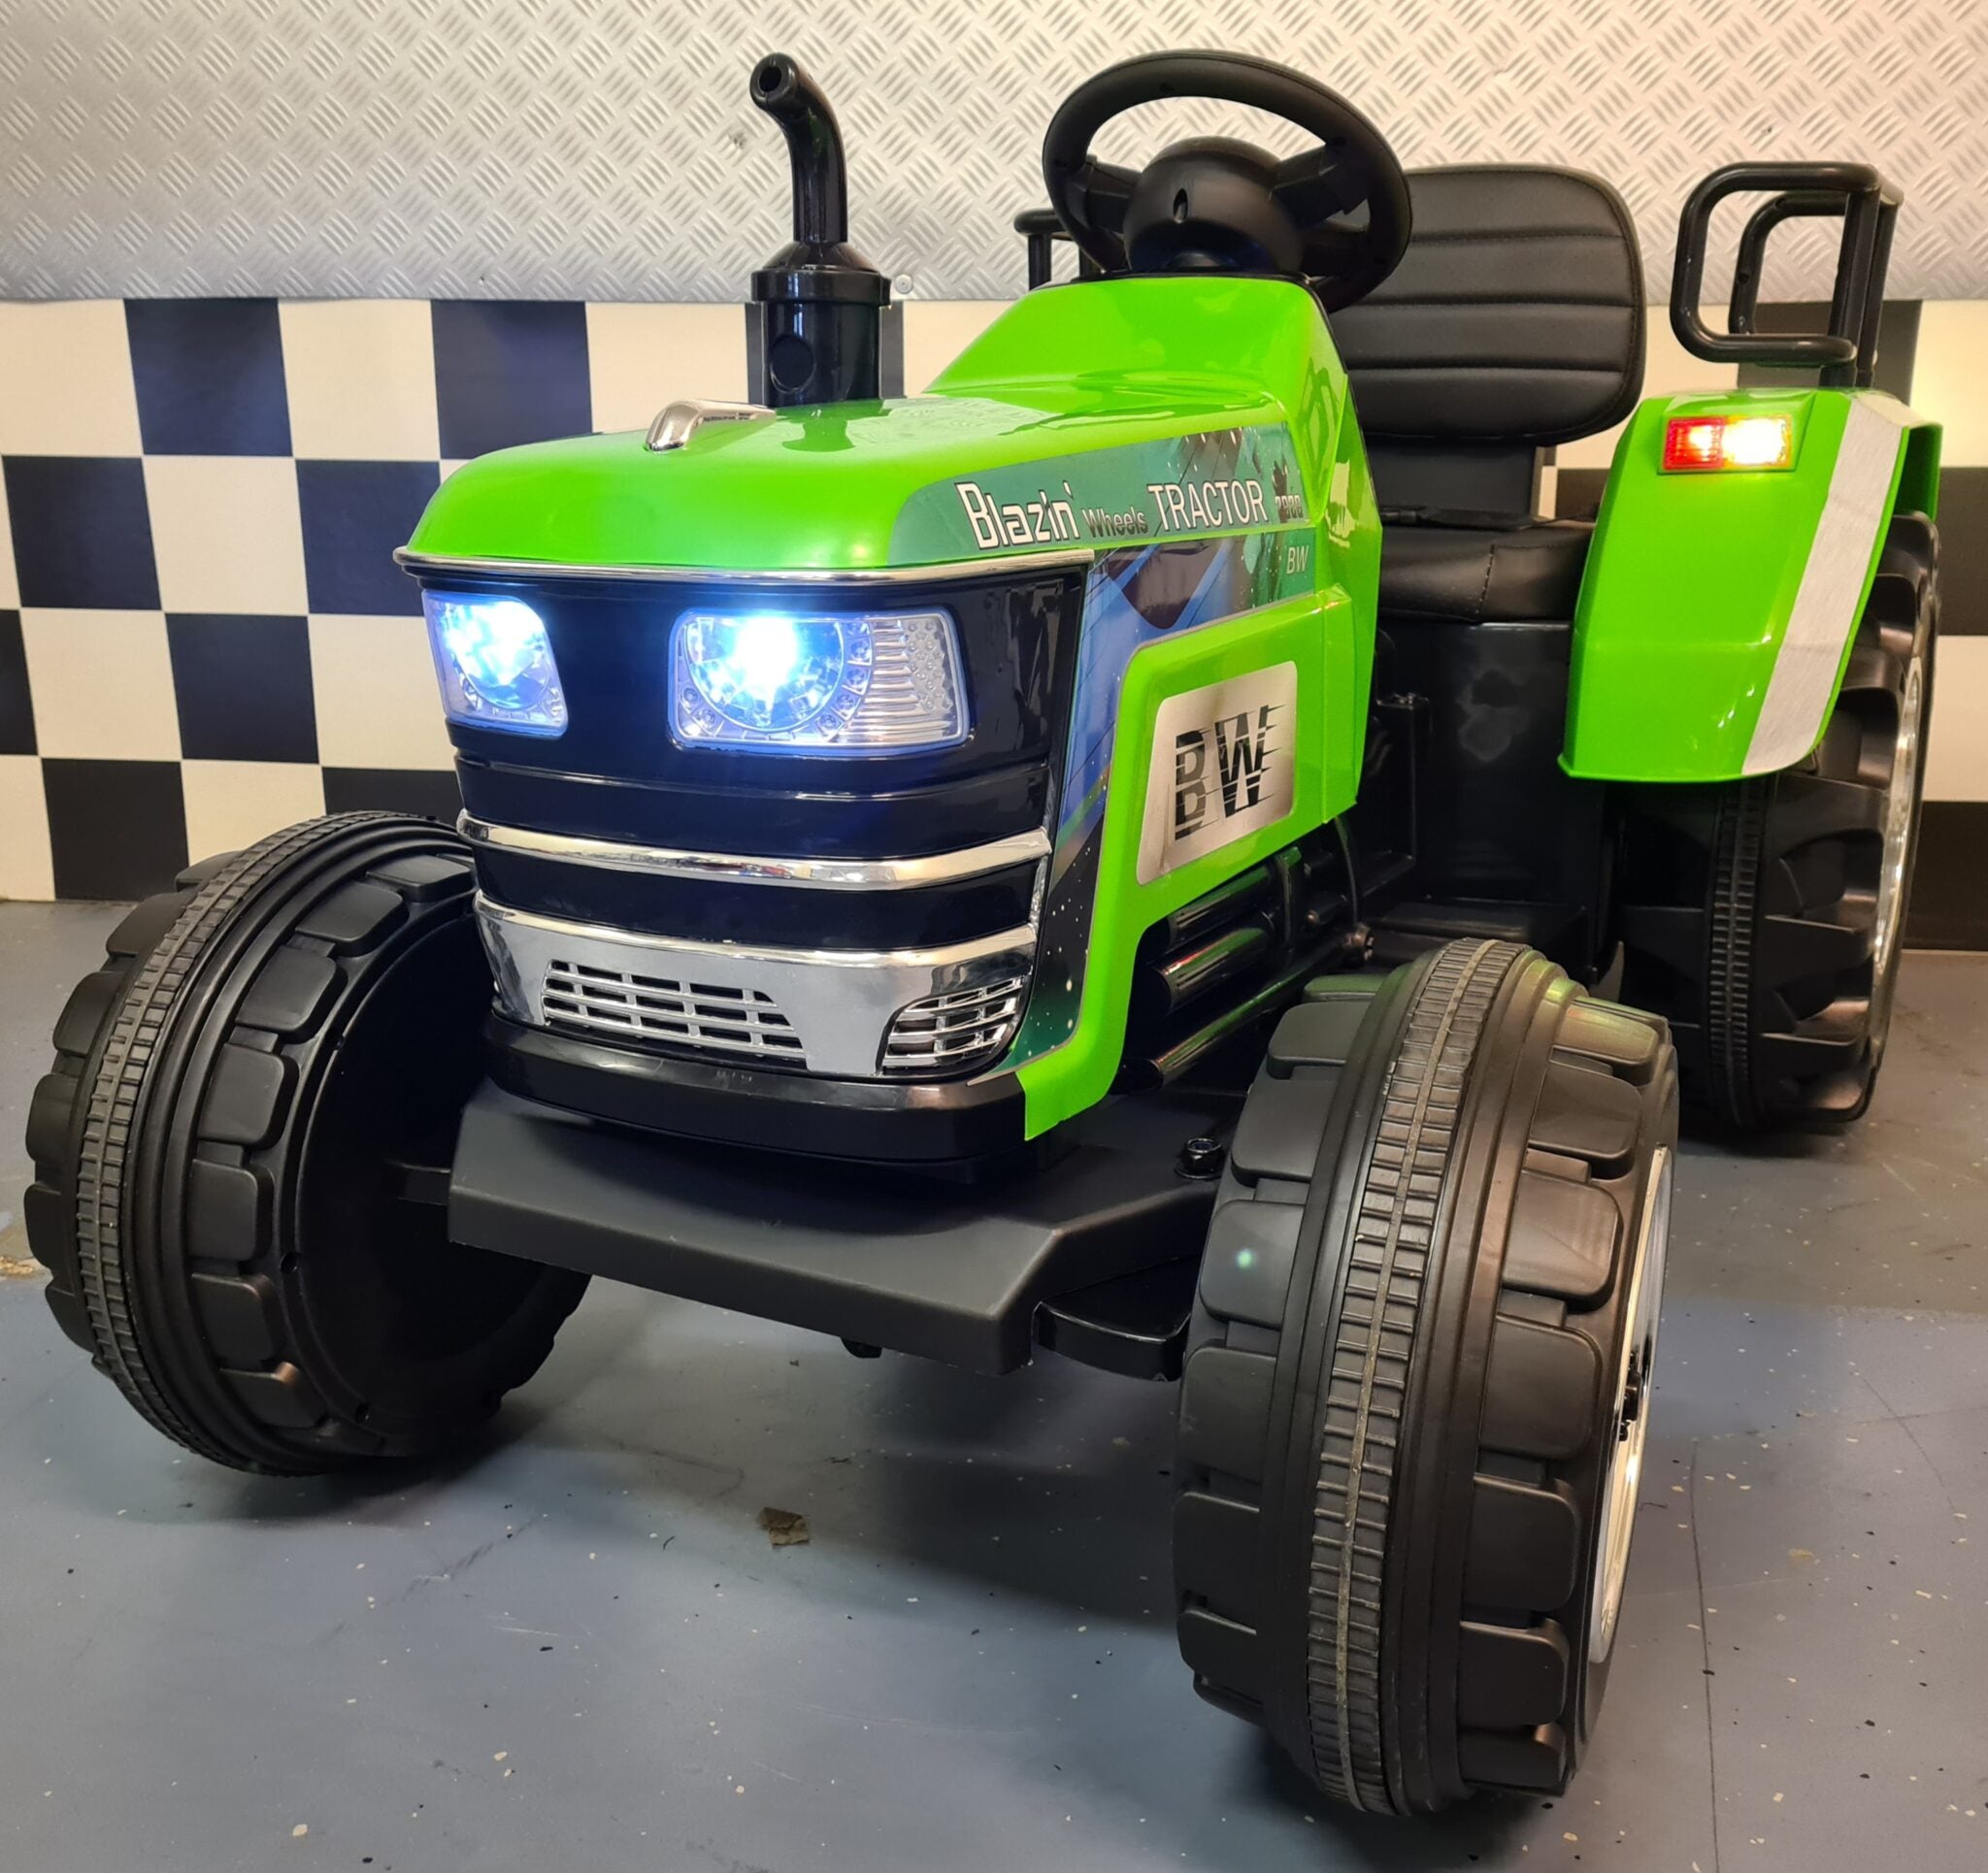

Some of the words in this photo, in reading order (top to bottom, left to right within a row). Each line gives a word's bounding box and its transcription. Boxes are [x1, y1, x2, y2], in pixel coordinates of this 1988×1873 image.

[1081, 506, 1148, 538] Wheels
[1147, 480, 1269, 531] TRACTOR
[1286, 545, 1309, 575] BW
[1175, 705, 1279, 840] BW
